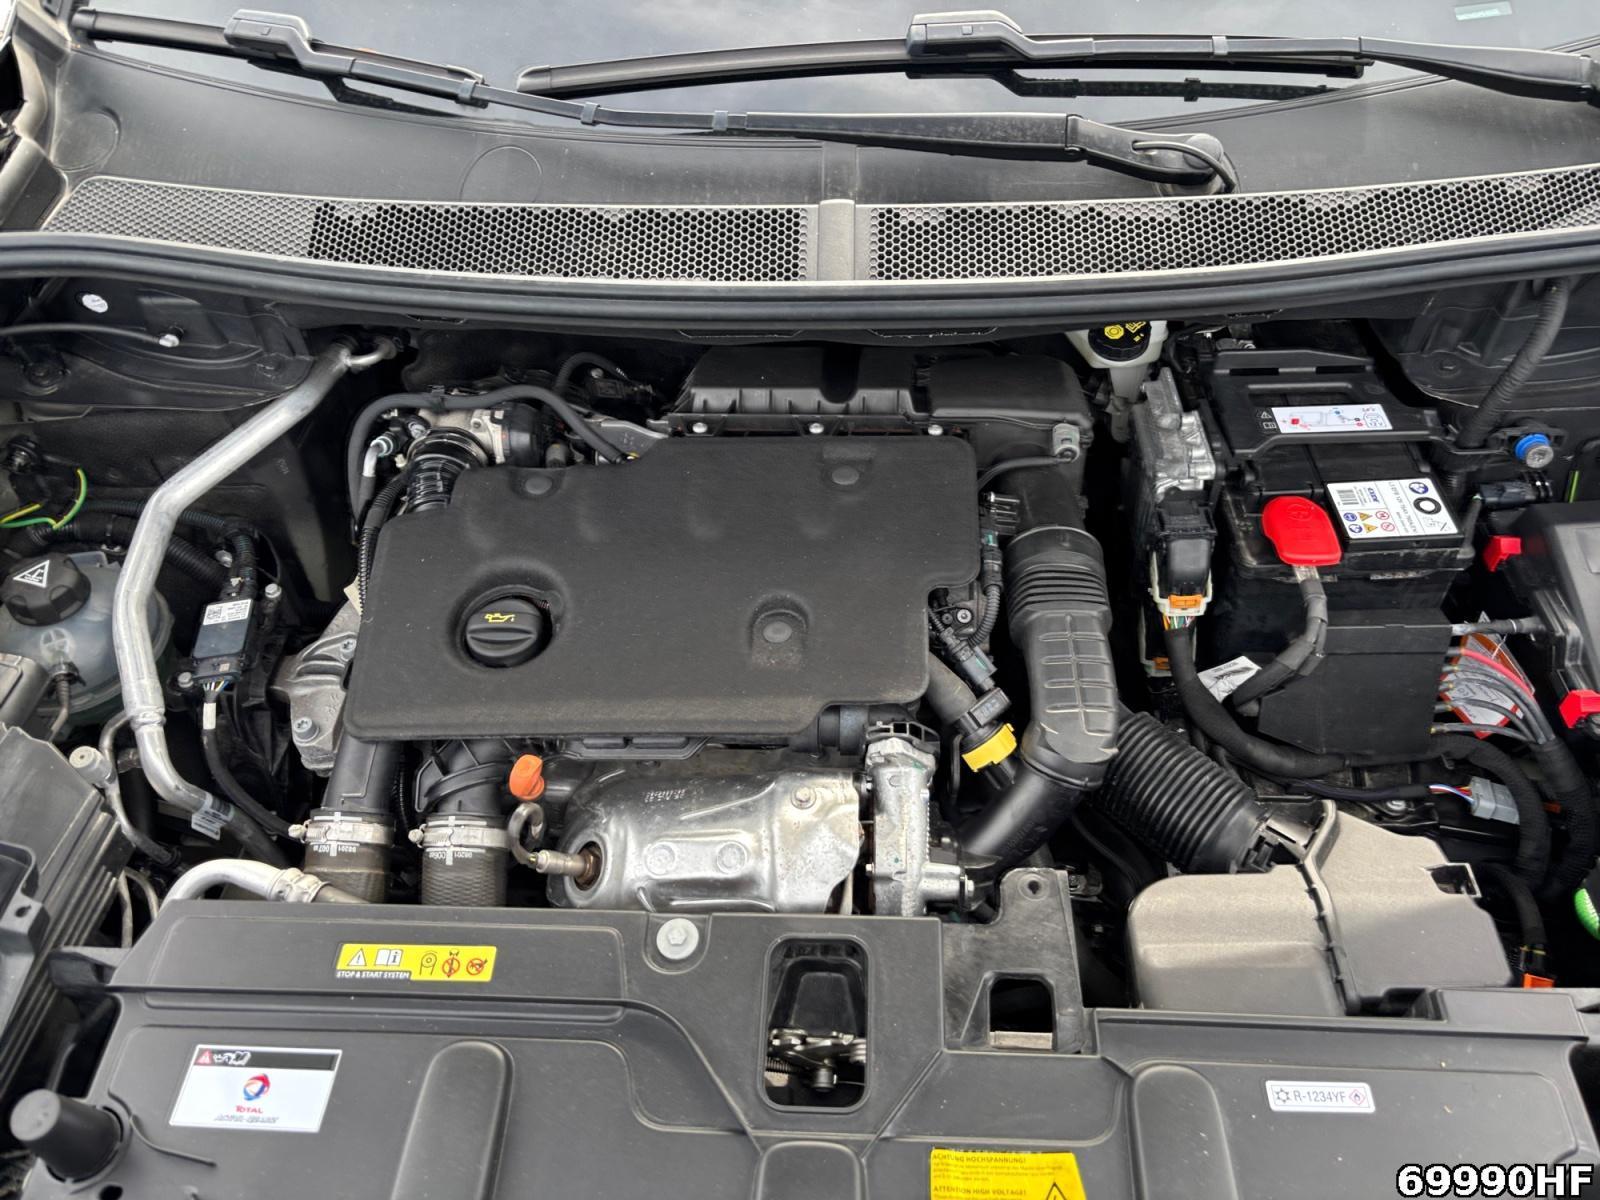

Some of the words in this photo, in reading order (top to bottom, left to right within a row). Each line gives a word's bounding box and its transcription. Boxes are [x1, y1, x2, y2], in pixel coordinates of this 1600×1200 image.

[382, 971, 410, 979] SYSTEM
[1293, 1090, 1346, 1103] R-1234YF
[236, 1105, 264, 1114] TOTAL
[933, 1153, 965, 1162] ACHTUNG
